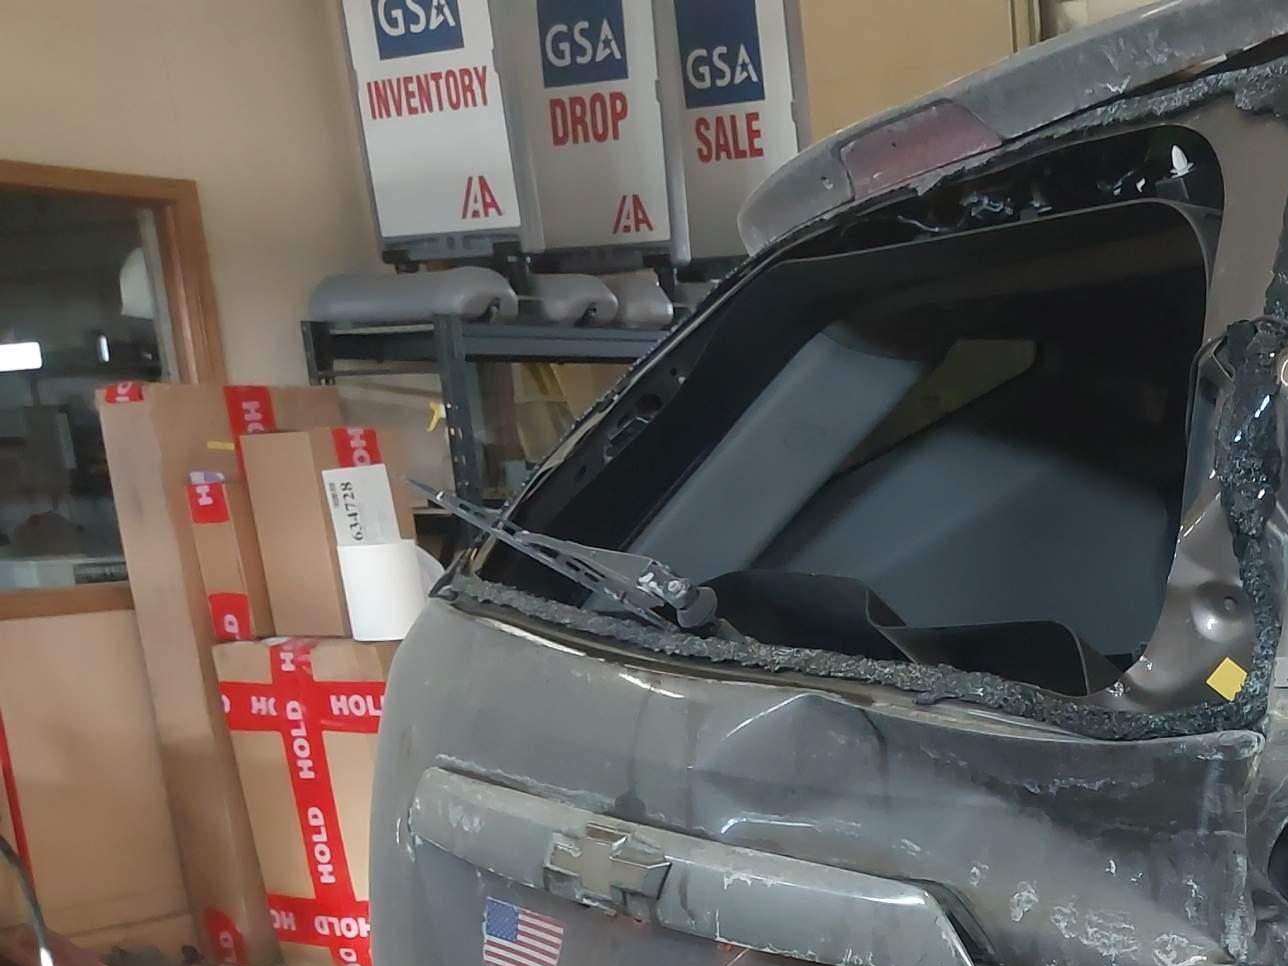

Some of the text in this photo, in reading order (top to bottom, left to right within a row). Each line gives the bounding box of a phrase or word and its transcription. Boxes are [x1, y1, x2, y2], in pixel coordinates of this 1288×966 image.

[377, 0, 456, 37] GSA
[544, 18, 622, 68] GSA
[366, 65, 488, 119] INVENTORY
[686, 43, 759, 89] GSA
[549, 91, 629, 147] DROP
[695, 112, 764, 164] SALE
[330, 694, 385, 717] HOL
[286, 700, 316, 779] HOLD
[307, 806, 336, 884] HOLD
